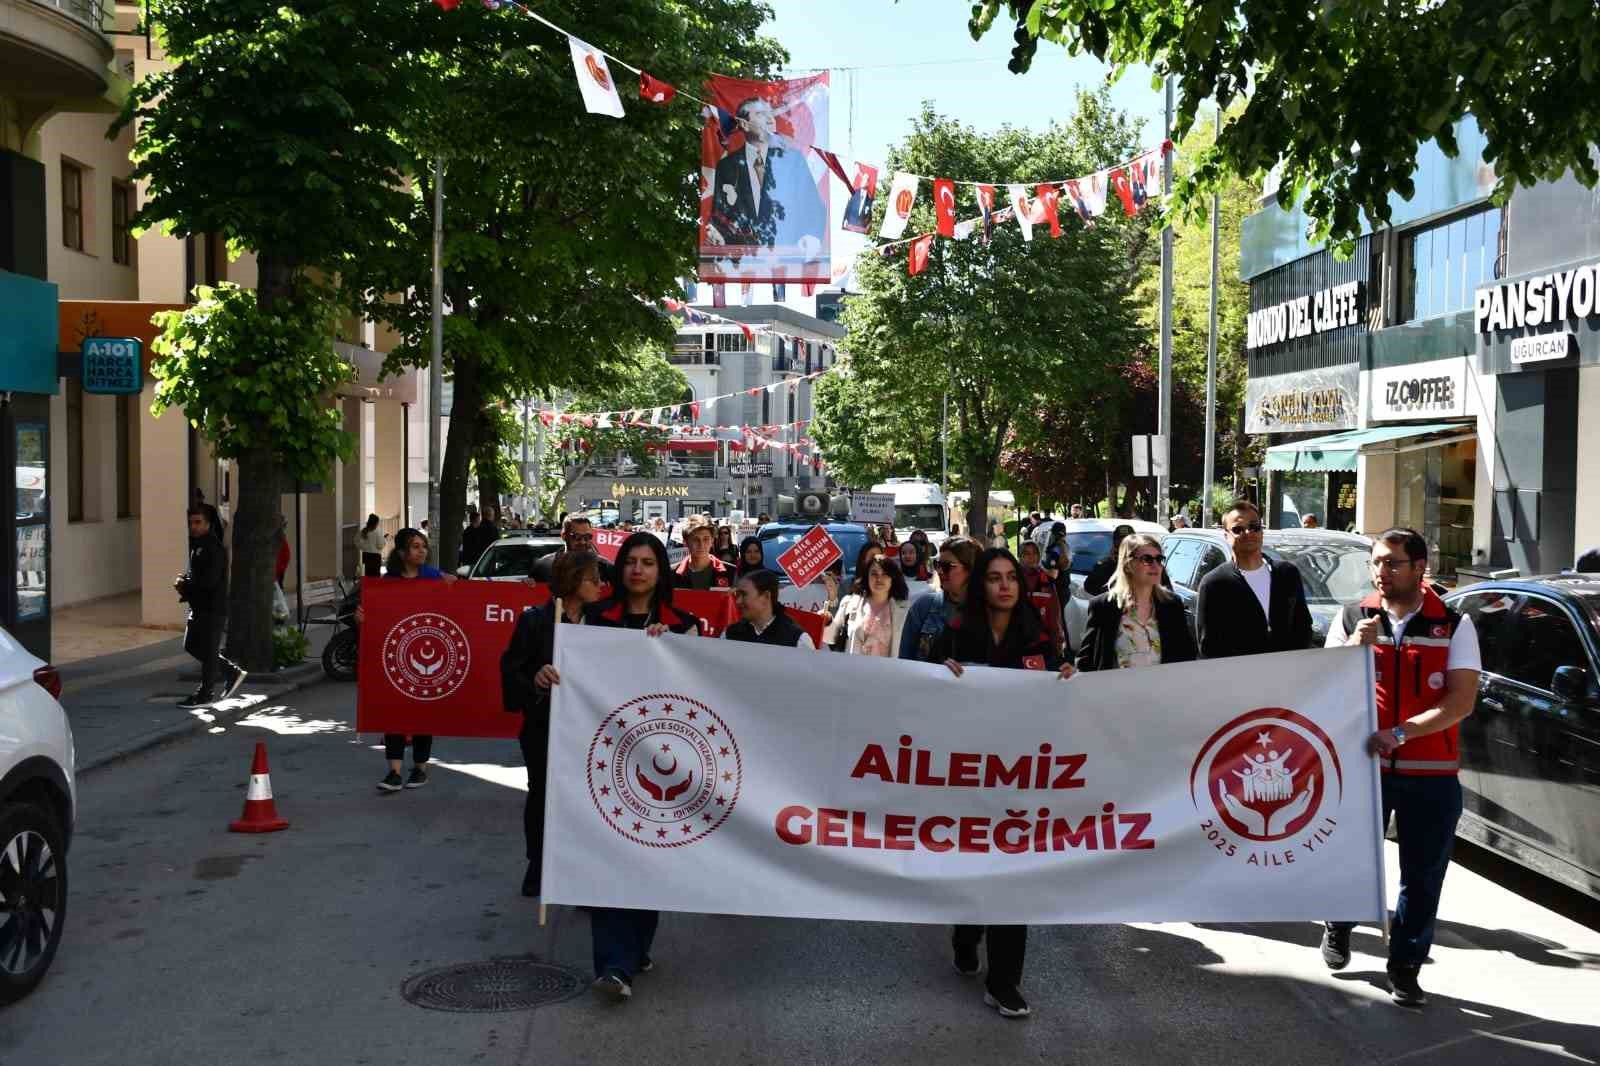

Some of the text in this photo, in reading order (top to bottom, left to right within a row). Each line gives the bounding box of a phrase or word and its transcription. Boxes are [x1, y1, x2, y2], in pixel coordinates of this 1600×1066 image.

[1247, 280, 1358, 349] MONDO DEL CAFFE
[1400, 376, 1450, 404] COFFEE
[625, 484, 689, 497] HALKBANK
[486, 603, 514, 623] En
[636, 724, 652, 737] AİLE
[655, 722, 666, 730] VE
[667, 722, 697, 742] SOSYAL
[850, 734, 1088, 790] AİLEMİZ
[775, 801, 1155, 854] GELECEĞİMİZ
[1200, 818, 1337, 867] 2025 AİLE YILI
